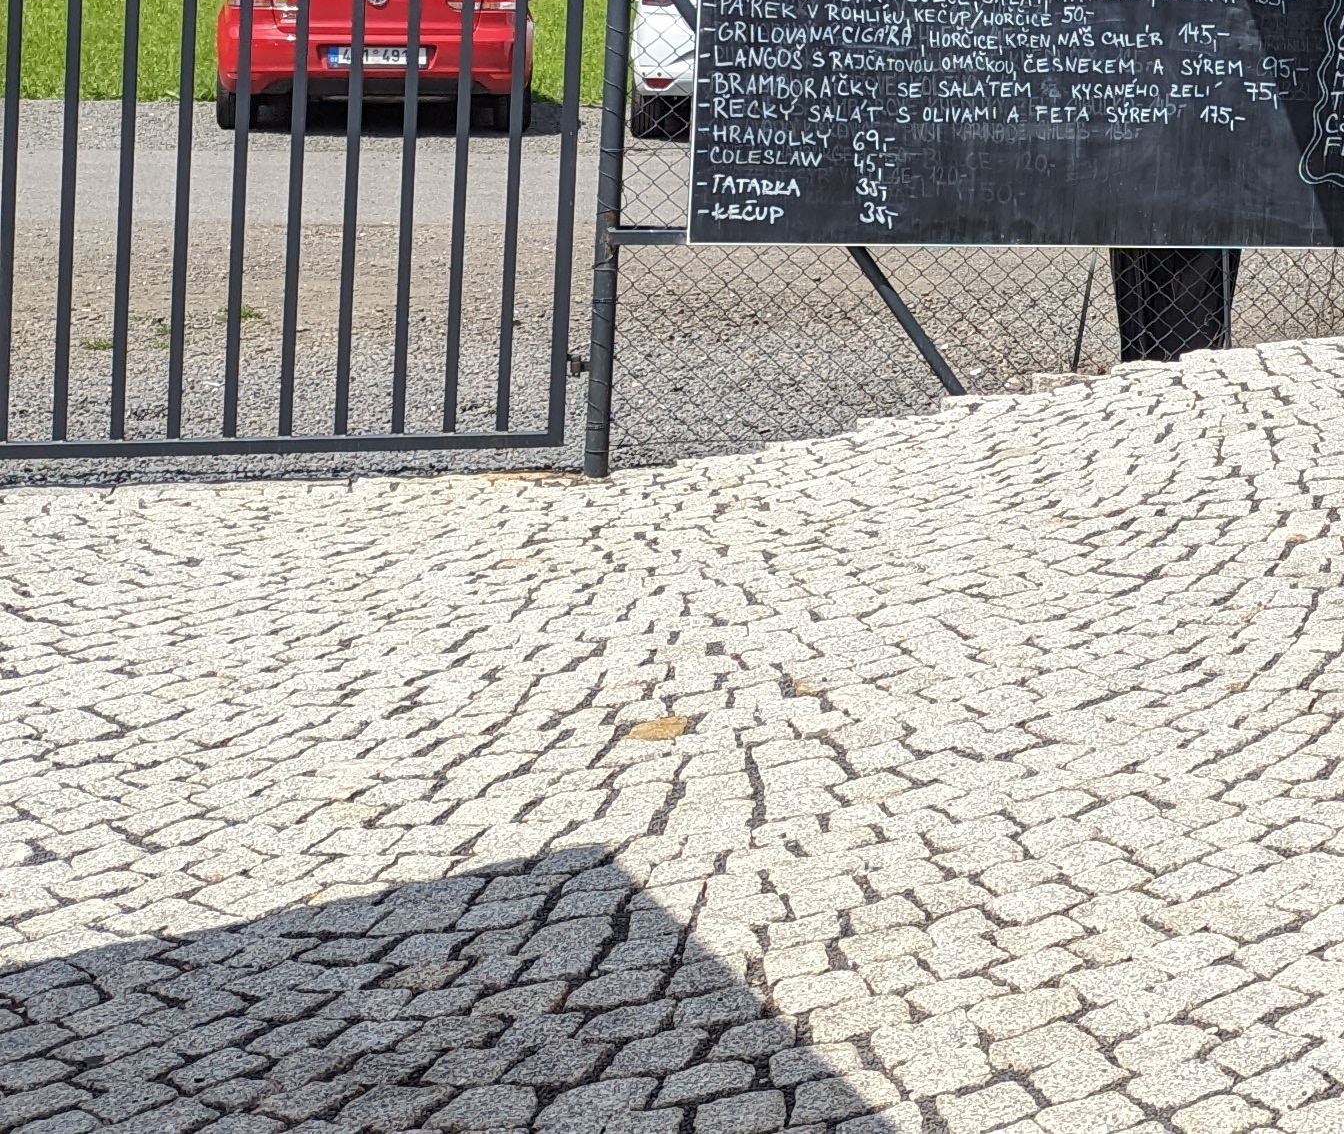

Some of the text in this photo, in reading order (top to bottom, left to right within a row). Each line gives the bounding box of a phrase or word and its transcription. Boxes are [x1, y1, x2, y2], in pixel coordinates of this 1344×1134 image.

[714, 43, 806, 71] LANGOŠ
[1023, 53, 1135, 76] ČESNEKEM
[1153, 58, 1164, 76] A
[1181, 54, 1243, 77] SÝREM
[897, 82, 923, 98] SE
[938, 75, 1032, 98] SALÁTEM
[1071, 77, 1160, 101] KYSANÉHO
[712, 94, 799, 121] ŘECKÝ
[808, 99, 884, 123] SALÁT
[896, 106, 911, 124] S
[922, 106, 997, 123] OLIVAMI
[1006, 106, 1020, 125] A
[1036, 106, 1090, 124] FETA
[1106, 100, 1170, 125] SÝREM
[712, 124, 832, 149] HRANOLKY
[710, 148, 824, 167] COLESLAW
[712, 174, 801, 198] TATARKA
